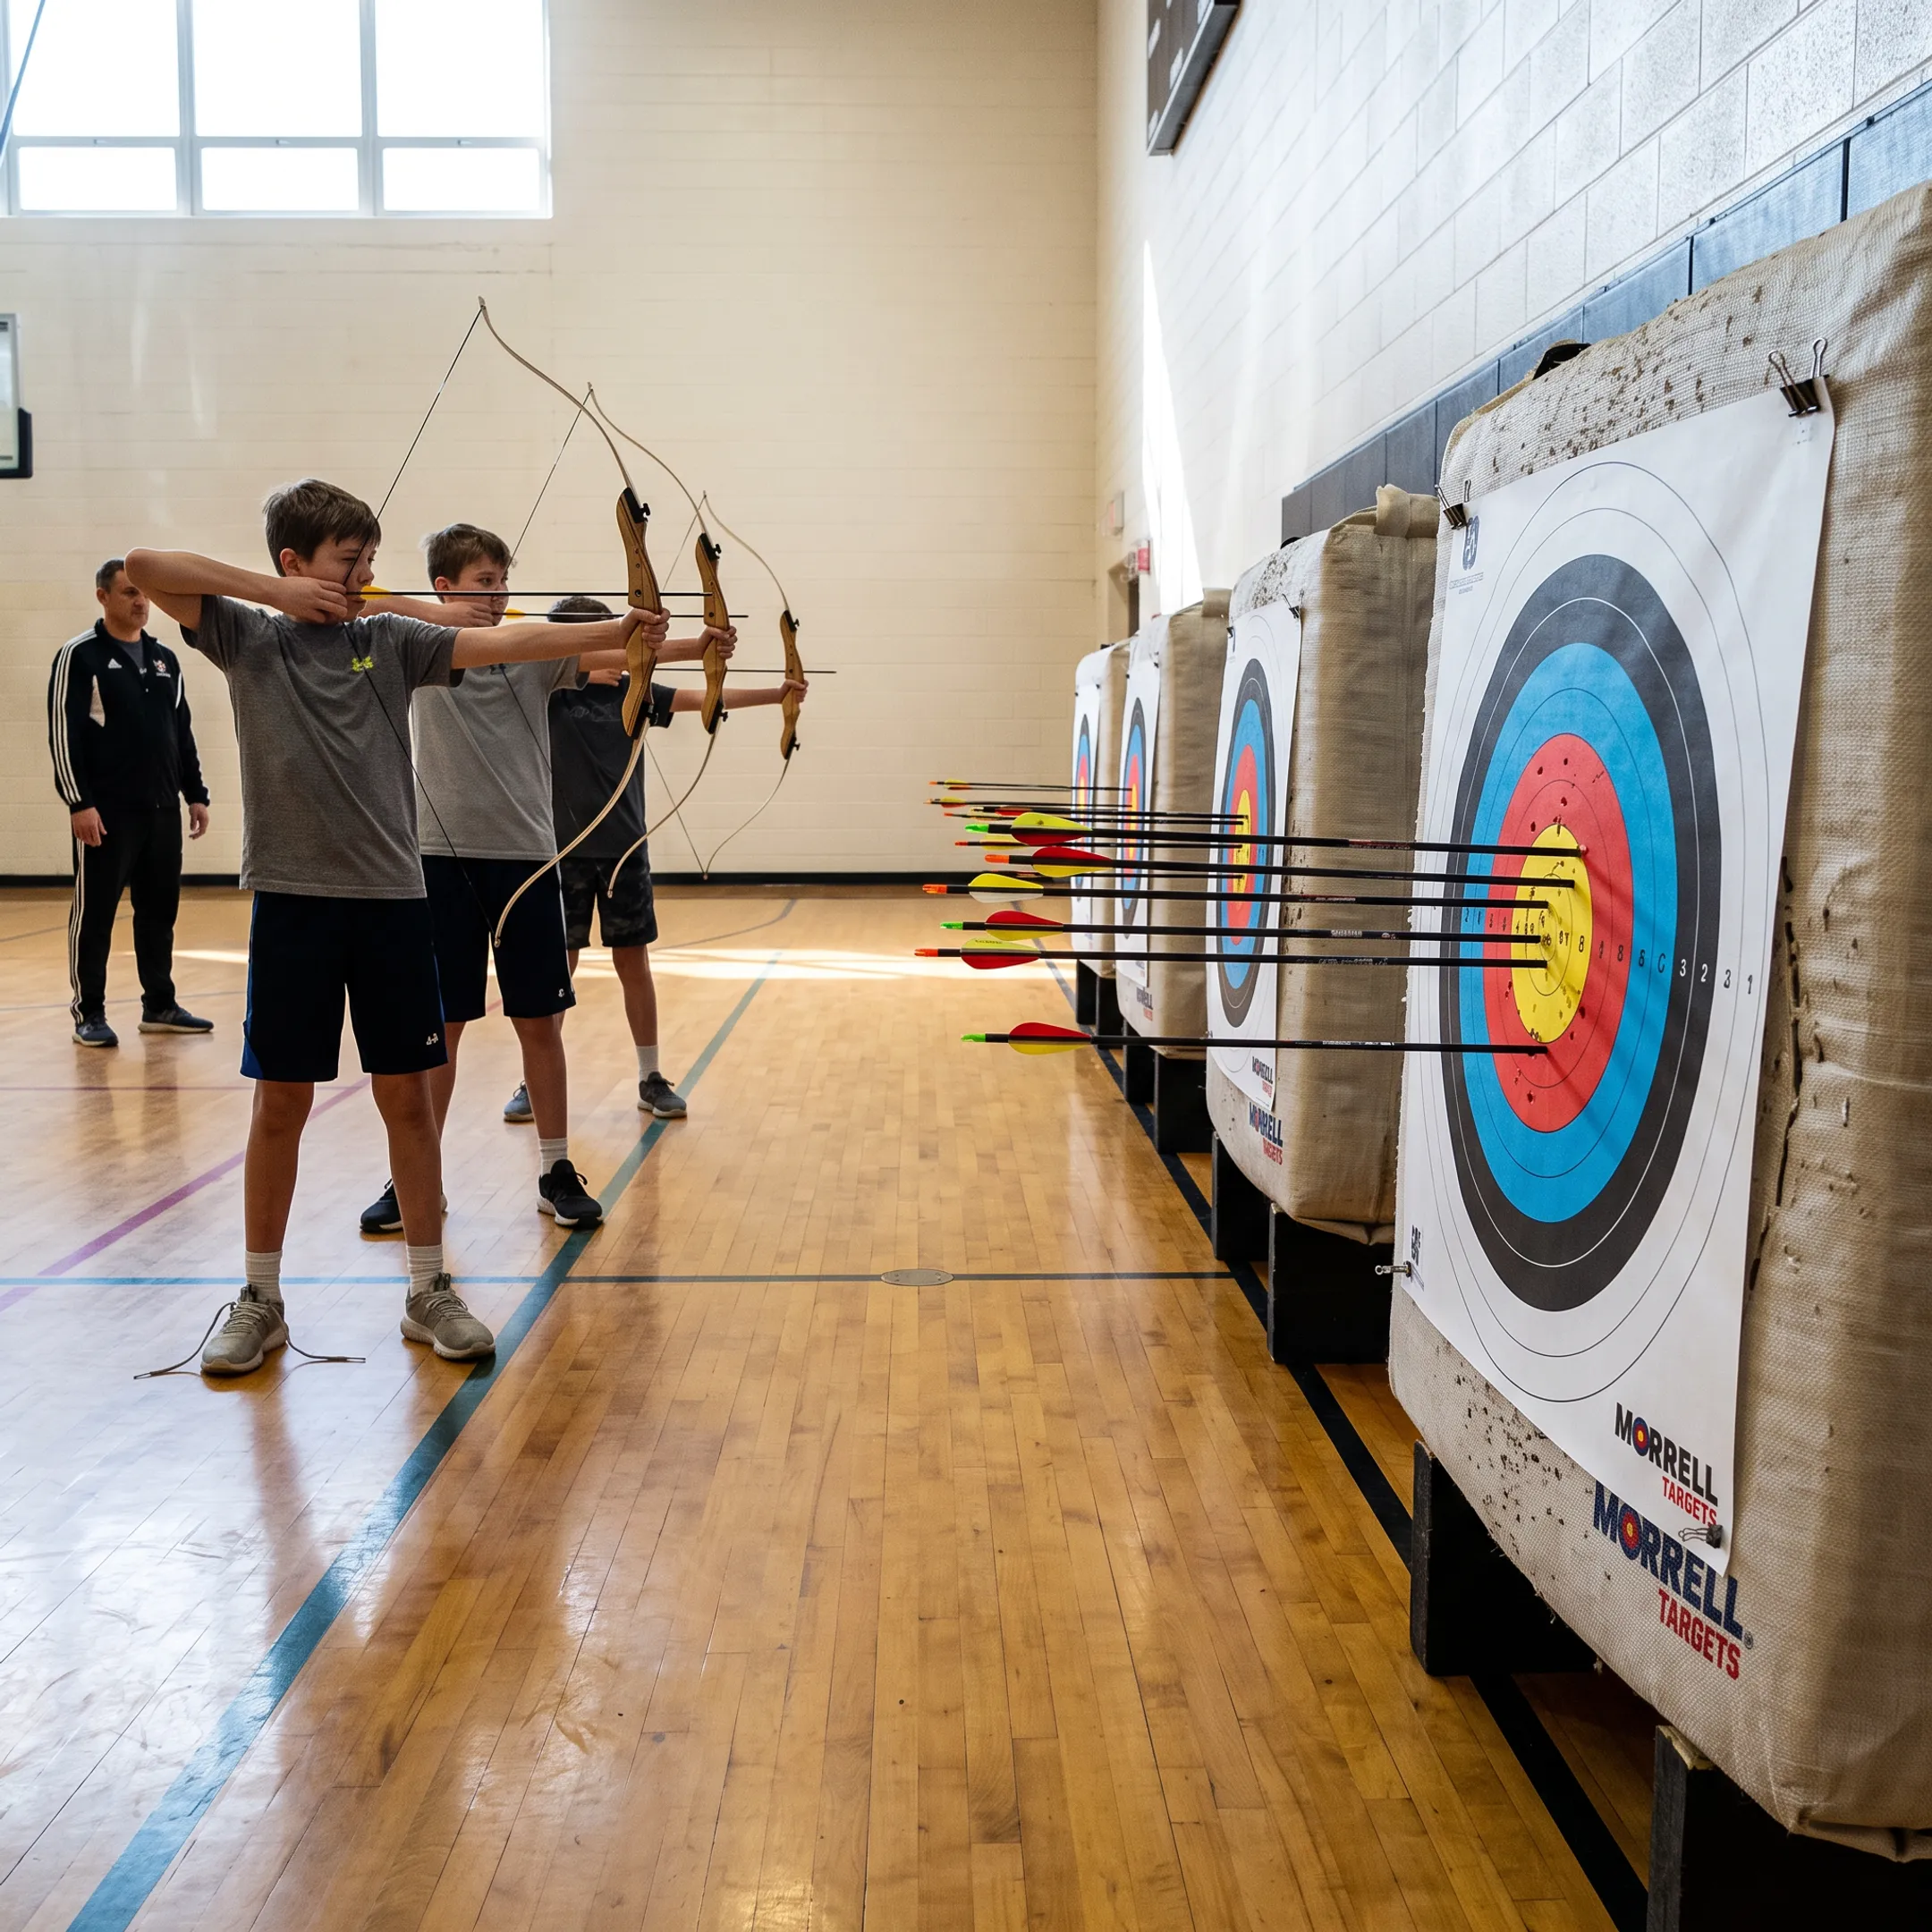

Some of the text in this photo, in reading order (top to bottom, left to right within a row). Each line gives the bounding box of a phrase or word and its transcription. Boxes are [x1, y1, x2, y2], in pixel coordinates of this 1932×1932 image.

[1614, 1402, 1718, 1506] MORRELL
[1662, 1476, 1717, 1527] TARGETS
[1593, 1479, 1743, 1640] MORRELL
[1658, 1588, 1741, 1681] TARGETS
